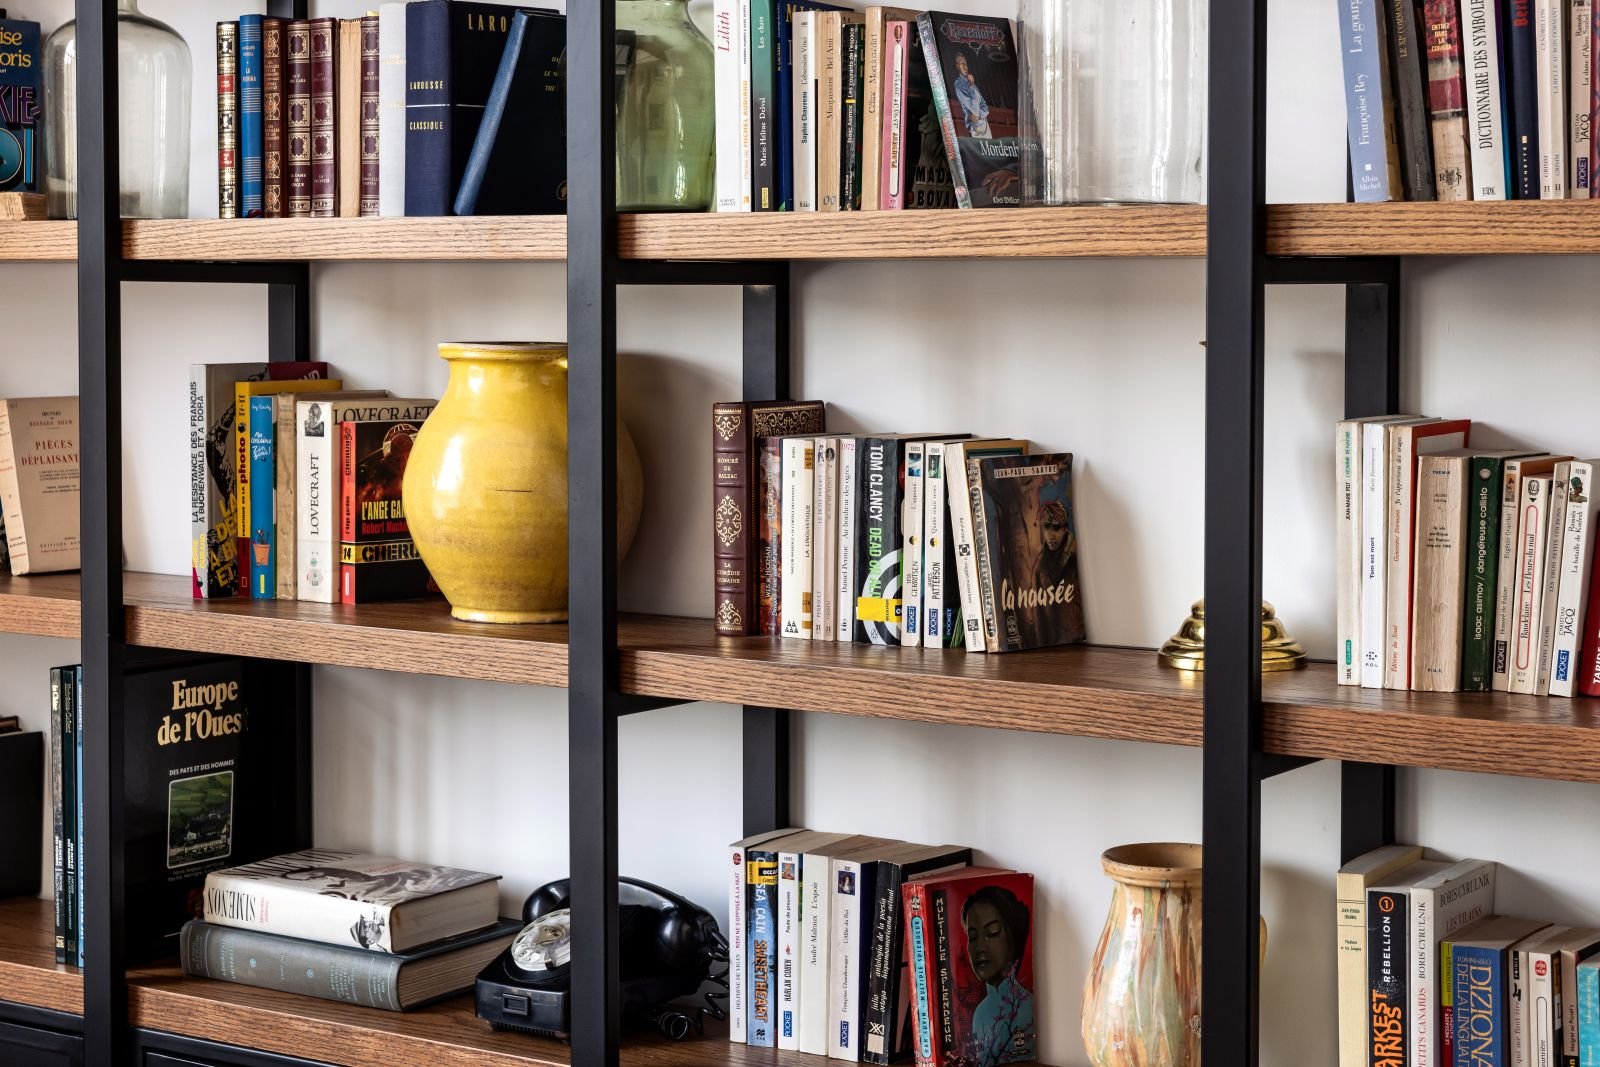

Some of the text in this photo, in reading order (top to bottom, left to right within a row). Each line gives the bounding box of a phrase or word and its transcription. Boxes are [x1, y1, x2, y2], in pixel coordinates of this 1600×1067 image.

[717, 10, 731, 53] Lilith
[756, 16, 765, 49] Les chats
[847, 27, 856, 52] l'espace
[1473, 49, 1488, 64] DES
[409, 80, 444, 91] LAROUSSE
[800, 37, 809, 144] Sophie Chauveau L'obsession Vinci
[825, 38, 834, 119] Maupassant Bel-Ami
[847, 62, 855, 87] courants
[1349, 36, 1371, 146] Françoise Rey La
[409, 121, 444, 131] CLASSIQUE
[1474, 71, 1493, 150] DICTIONNAIRE
[758, 97, 768, 167] Marie-Hélène Delval
[1579, 113, 1590, 142] JACQ
[1578, 157, 1587, 189] POCKET
[196, 395, 205, 422] DORA
[334, 406, 431, 426] LOVECRAFT
[35, 438, 73, 451] PIÈCES
[196, 436, 205, 448] ET
[869, 444, 884, 471] TOM
[238, 437, 248, 484] photo
[844, 465, 852, 484] ogres
[995, 465, 1058, 479] JEAN-PAUL SARTRE
[191, 451, 199, 509] RESISTANCE
[196, 450, 206, 515] BUCHENWALD
[310, 453, 320, 536] LOVECRAFT
[361, 501, 389, 521] L'ANGE
[842, 498, 850, 528] bonheur
[869, 473, 884, 522] CLANCY
[1477, 487, 1489, 519] callisto
[191, 513, 199, 523] LA
[1503, 512, 1514, 536] Grandet
[1567, 509, 1577, 532] Ramsès
[842, 530, 849, 540] Au
[868, 527, 882, 556] DEAD
[1502, 535, 1512, 559] Eugénie
[1571, 511, 1584, 574] La bataille de Kadesh
[343, 547, 352, 560] 14
[804, 549, 810, 558] LA
[841, 544, 849, 570] Pennac
[868, 559, 882, 576] OR
[716, 569, 741, 577] COMÉDIE
[911, 560, 919, 598] GERRITSEN
[931, 562, 941, 600] PATTERSON
[1519, 533, 1535, 640] Baudelaire Les fleurs du mal
[1001, 578, 1016, 612] la
[1017, 579, 1075, 609] nausée
[1474, 581, 1485, 614] asimov
[907, 606, 916, 634] POCKET
[929, 608, 938, 636] POCKET
[1472, 615, 1484, 640] isaac
[1563, 607, 1576, 636] JACQ
[1390, 624, 1399, 673] Éditions Seuil
[1496, 640, 1507, 673] POCKET
[1556, 649, 1569, 682] POCKET
[171, 677, 238, 712] Europe
[157, 708, 243, 747] de l'Oues
[169, 759, 234, 777] DES PAYS ET DES HOMMES
[206, 887, 256, 922] SIMENON
[1440, 872, 1490, 908] BORIS CYRULNIK
[810, 881, 820, 966] André Malraux L'espoir
[874, 897, 888, 978] antología de la poesía
[882, 888, 895, 980] hispanoamericana actual
[752, 907, 769, 1024] CAIN SWEETHEART
[1382, 916, 1391, 983] RÉBELLION
[784, 958, 793, 978] COBEN
[935, 897, 951, 1043] MULTIPLE SPLENDEUR
[1418, 901, 1427, 1035] CANARDS BORIS CYRULNIK
[784, 978, 793, 1002] HARLAN
[872, 993, 881, 1012] julio
[879, 990, 889, 1014] ortega
[914, 920, 931, 1054] HAN SUYIN MULTIPLE SPLENDEUR
[784, 1010, 793, 1038] POCKET
[840, 990, 850, 1048] POCKET Françoise
[1456, 963, 1470, 1057] DELLA LINGUA
